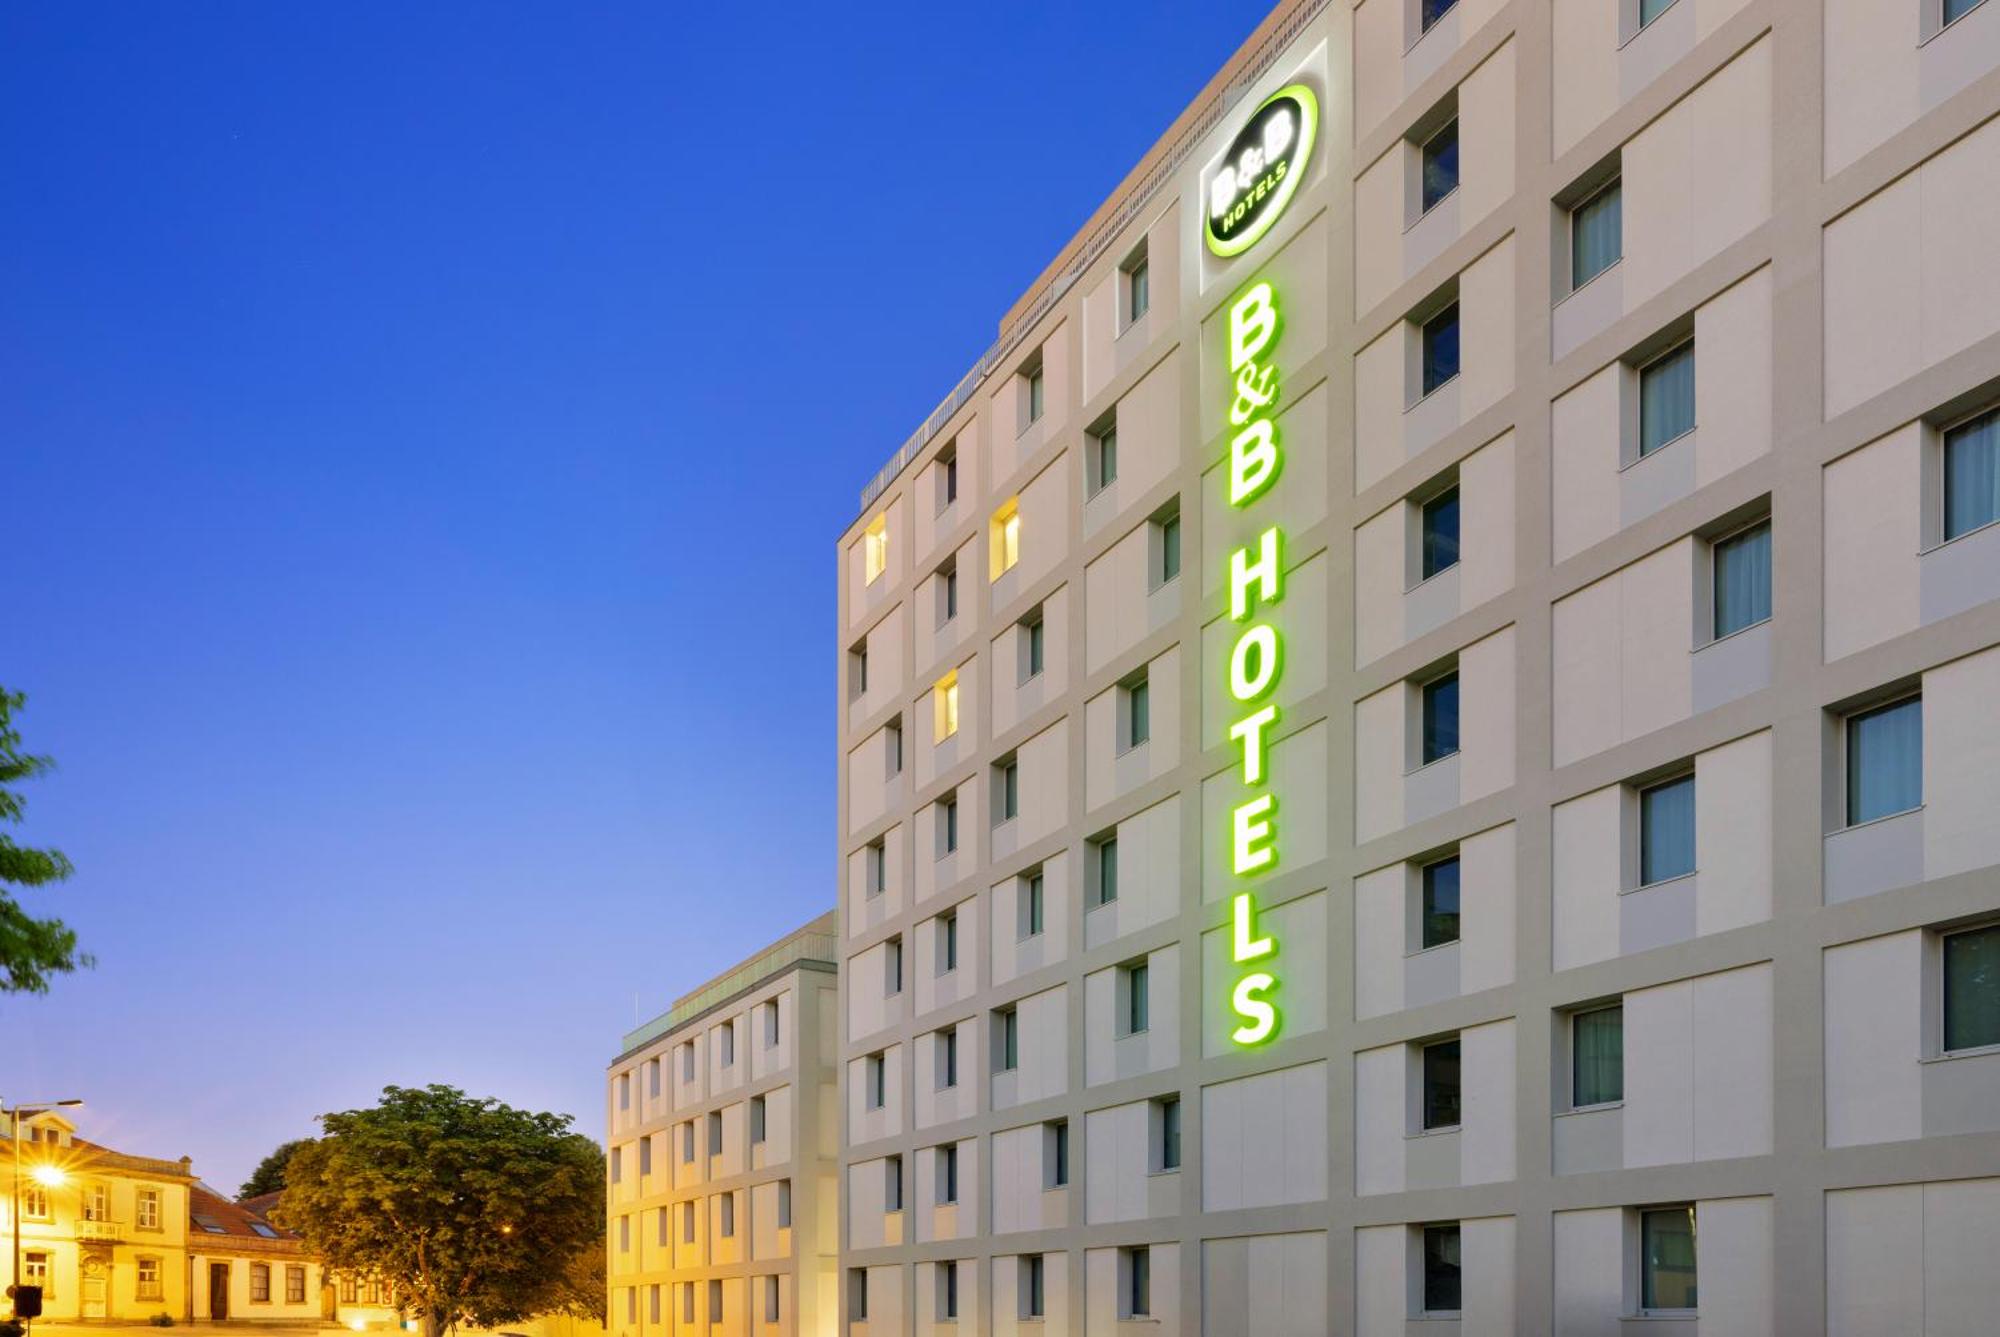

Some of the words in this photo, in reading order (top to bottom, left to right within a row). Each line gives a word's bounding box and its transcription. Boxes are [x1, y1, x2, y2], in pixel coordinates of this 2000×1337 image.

[1223, 160, 1288, 233] HOTELS
[1229, 282, 1278, 505] B&B
[1229, 526, 1278, 1045] HOTELS
